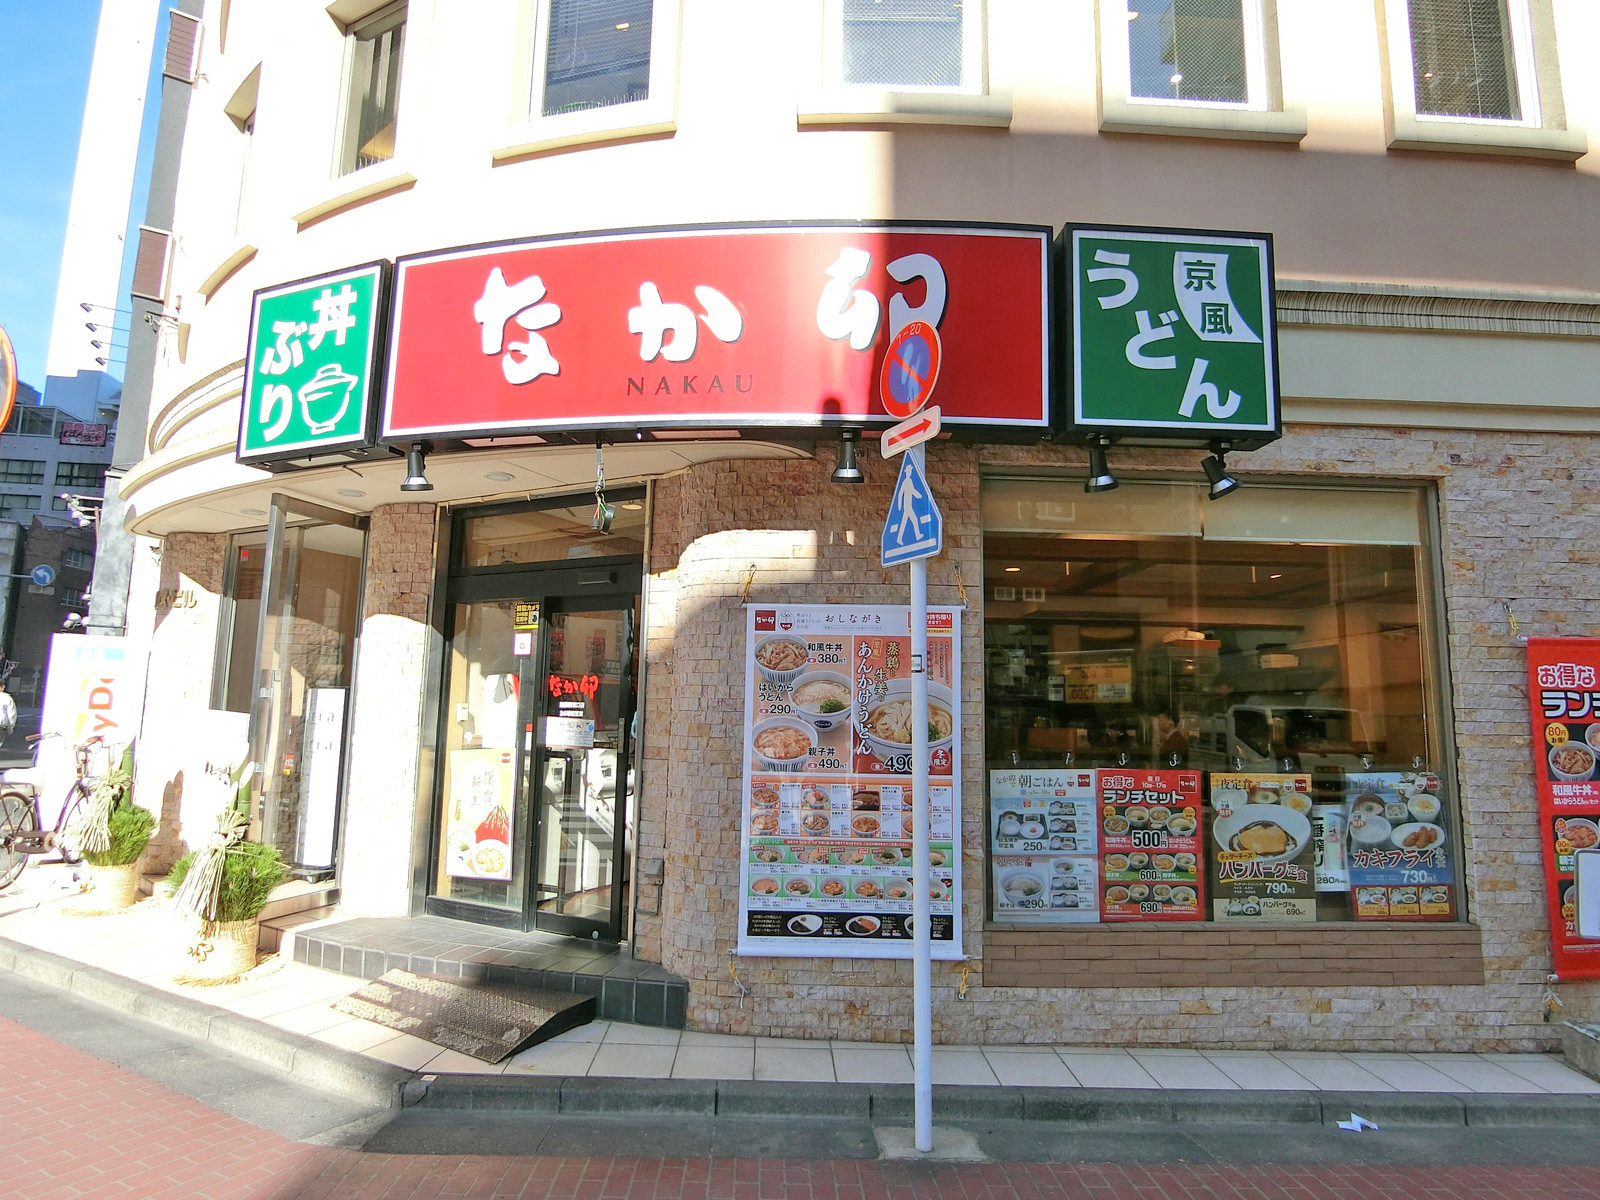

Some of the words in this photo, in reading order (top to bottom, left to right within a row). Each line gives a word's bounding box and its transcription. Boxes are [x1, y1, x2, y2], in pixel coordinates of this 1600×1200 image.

[1183, 259, 1233, 336] 京風
[1086, 248, 1242, 419] うどん
[626, 374, 753, 396] NAKAU
[825, 614, 882, 625] おしながき
[808, 643, 844, 653] 和風牛丼
[1538, 663, 1596, 688] お得な
[549, 673, 600, 701] なか卯
[759, 682, 794, 692] はいから
[758, 692, 784, 702] うどん
[857, 641, 874, 755] あんかけうどん
[1547, 726, 1567, 737] 80円
[808, 748, 836, 757] 親子丼
[1018, 774, 1064, 788] 朝ごはん
[1102, 776, 1135, 790] お得な
[1220, 779, 1253, 790] 夜定食
[1552, 784, 1593, 796] 和風牛丼
[1102, 790, 1186, 805] ランチセット
[1353, 848, 1435, 870] カキフライ
[1219, 860, 1308, 882] ハンバーグ定食
